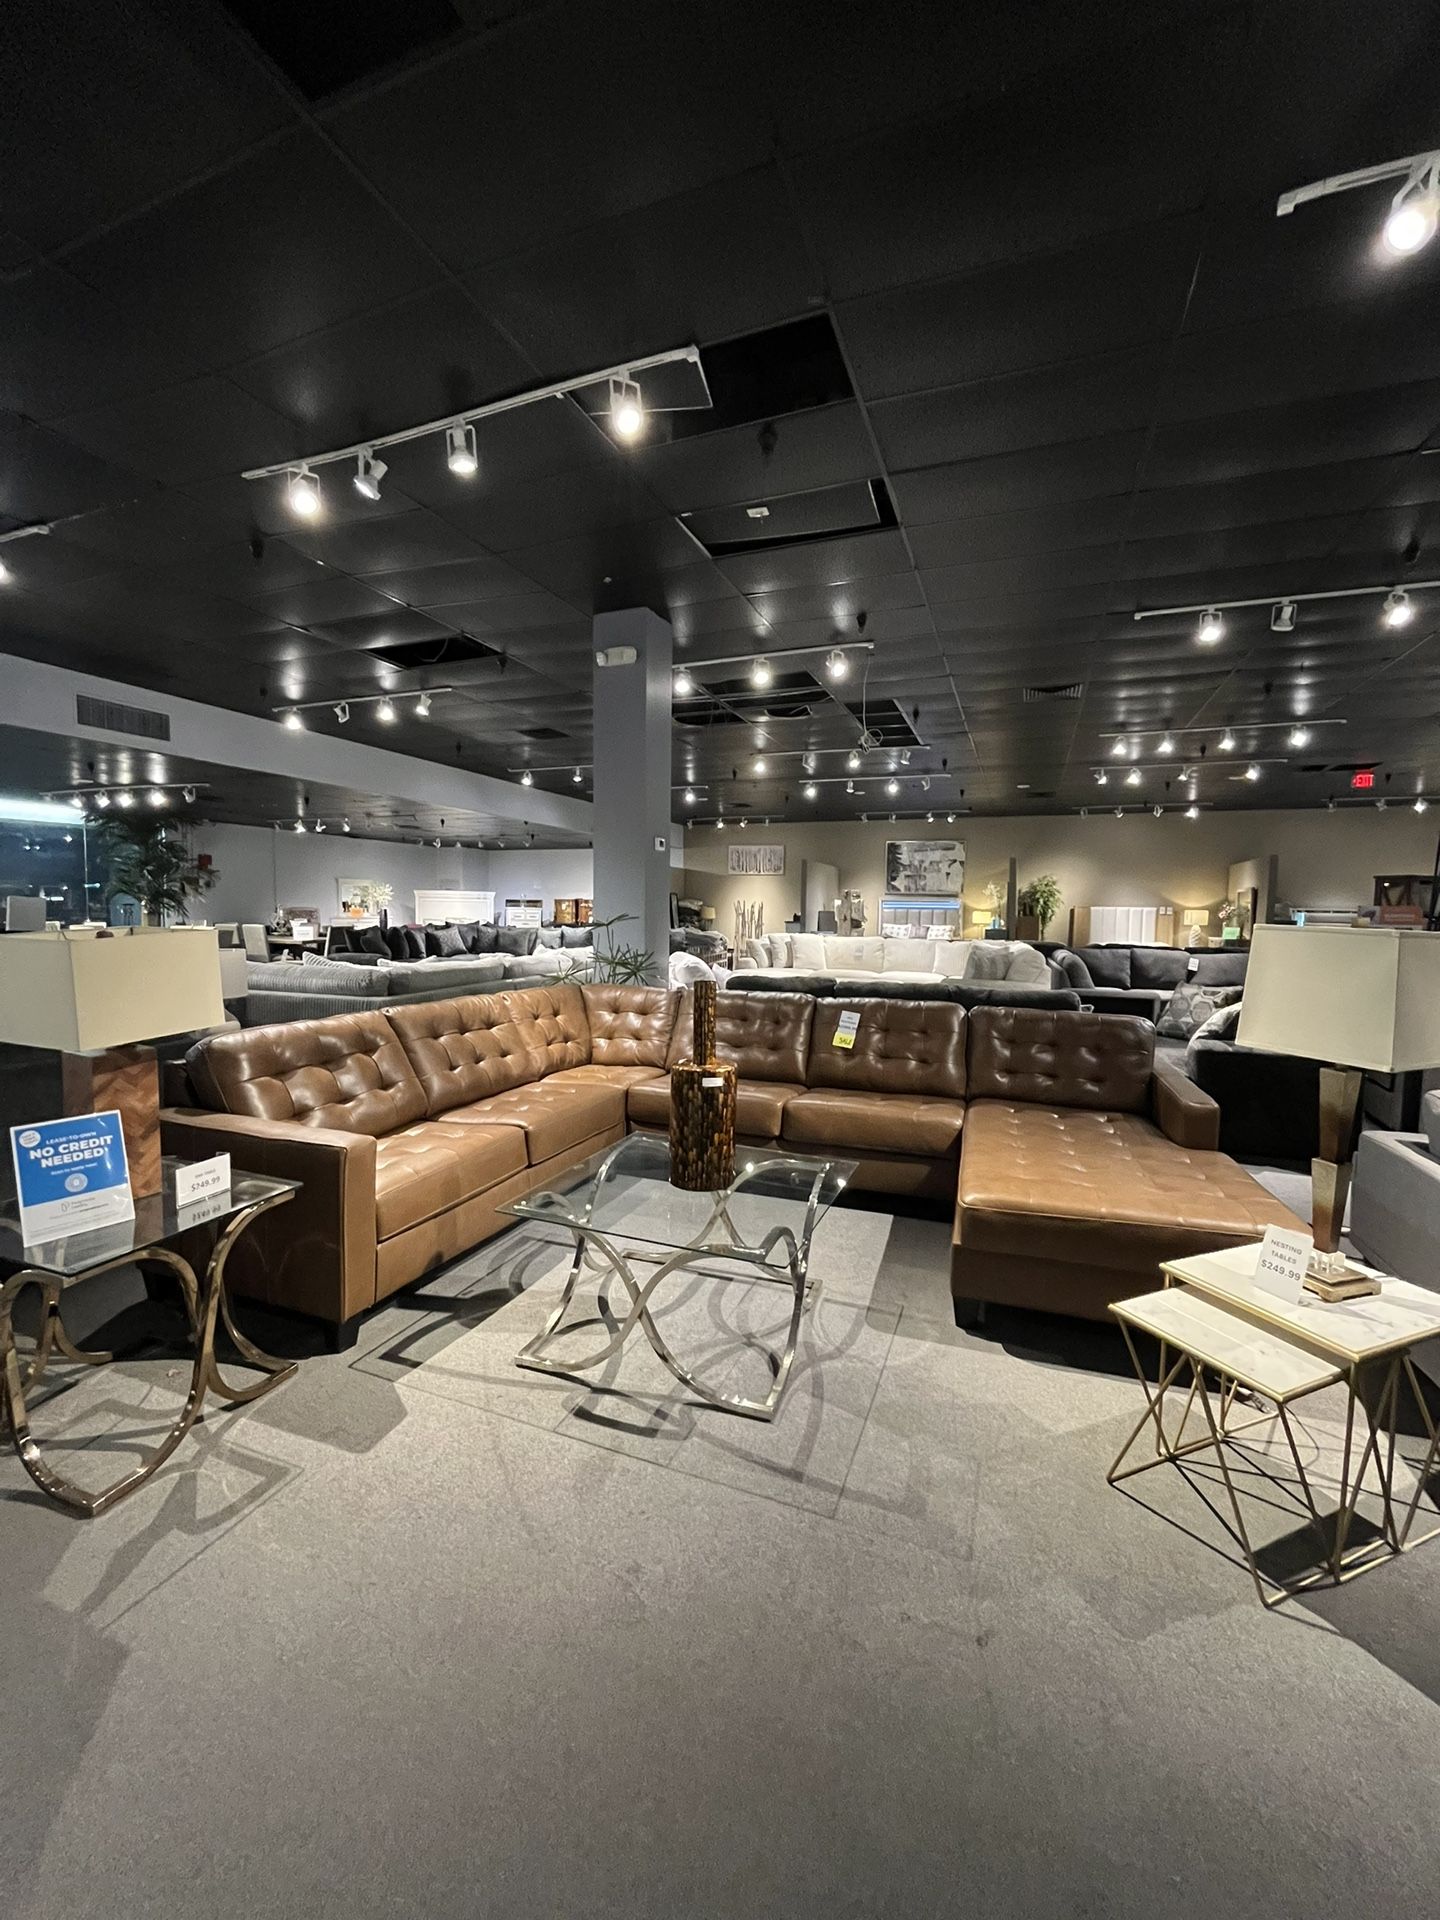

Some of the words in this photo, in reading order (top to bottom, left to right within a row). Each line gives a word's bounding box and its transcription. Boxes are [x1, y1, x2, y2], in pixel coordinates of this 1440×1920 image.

[1355, 774, 1374, 787] EXIT
[29, 1146, 55, 1160] NO
[58, 1135, 113, 1153] CREDIT
[40, 1147, 105, 1168] NEEDED
[1270, 1239, 1303, 1255] NESTING
[1271, 1250, 1297, 1265] TABLES
[1261, 1259, 1301, 1281] $249.99
